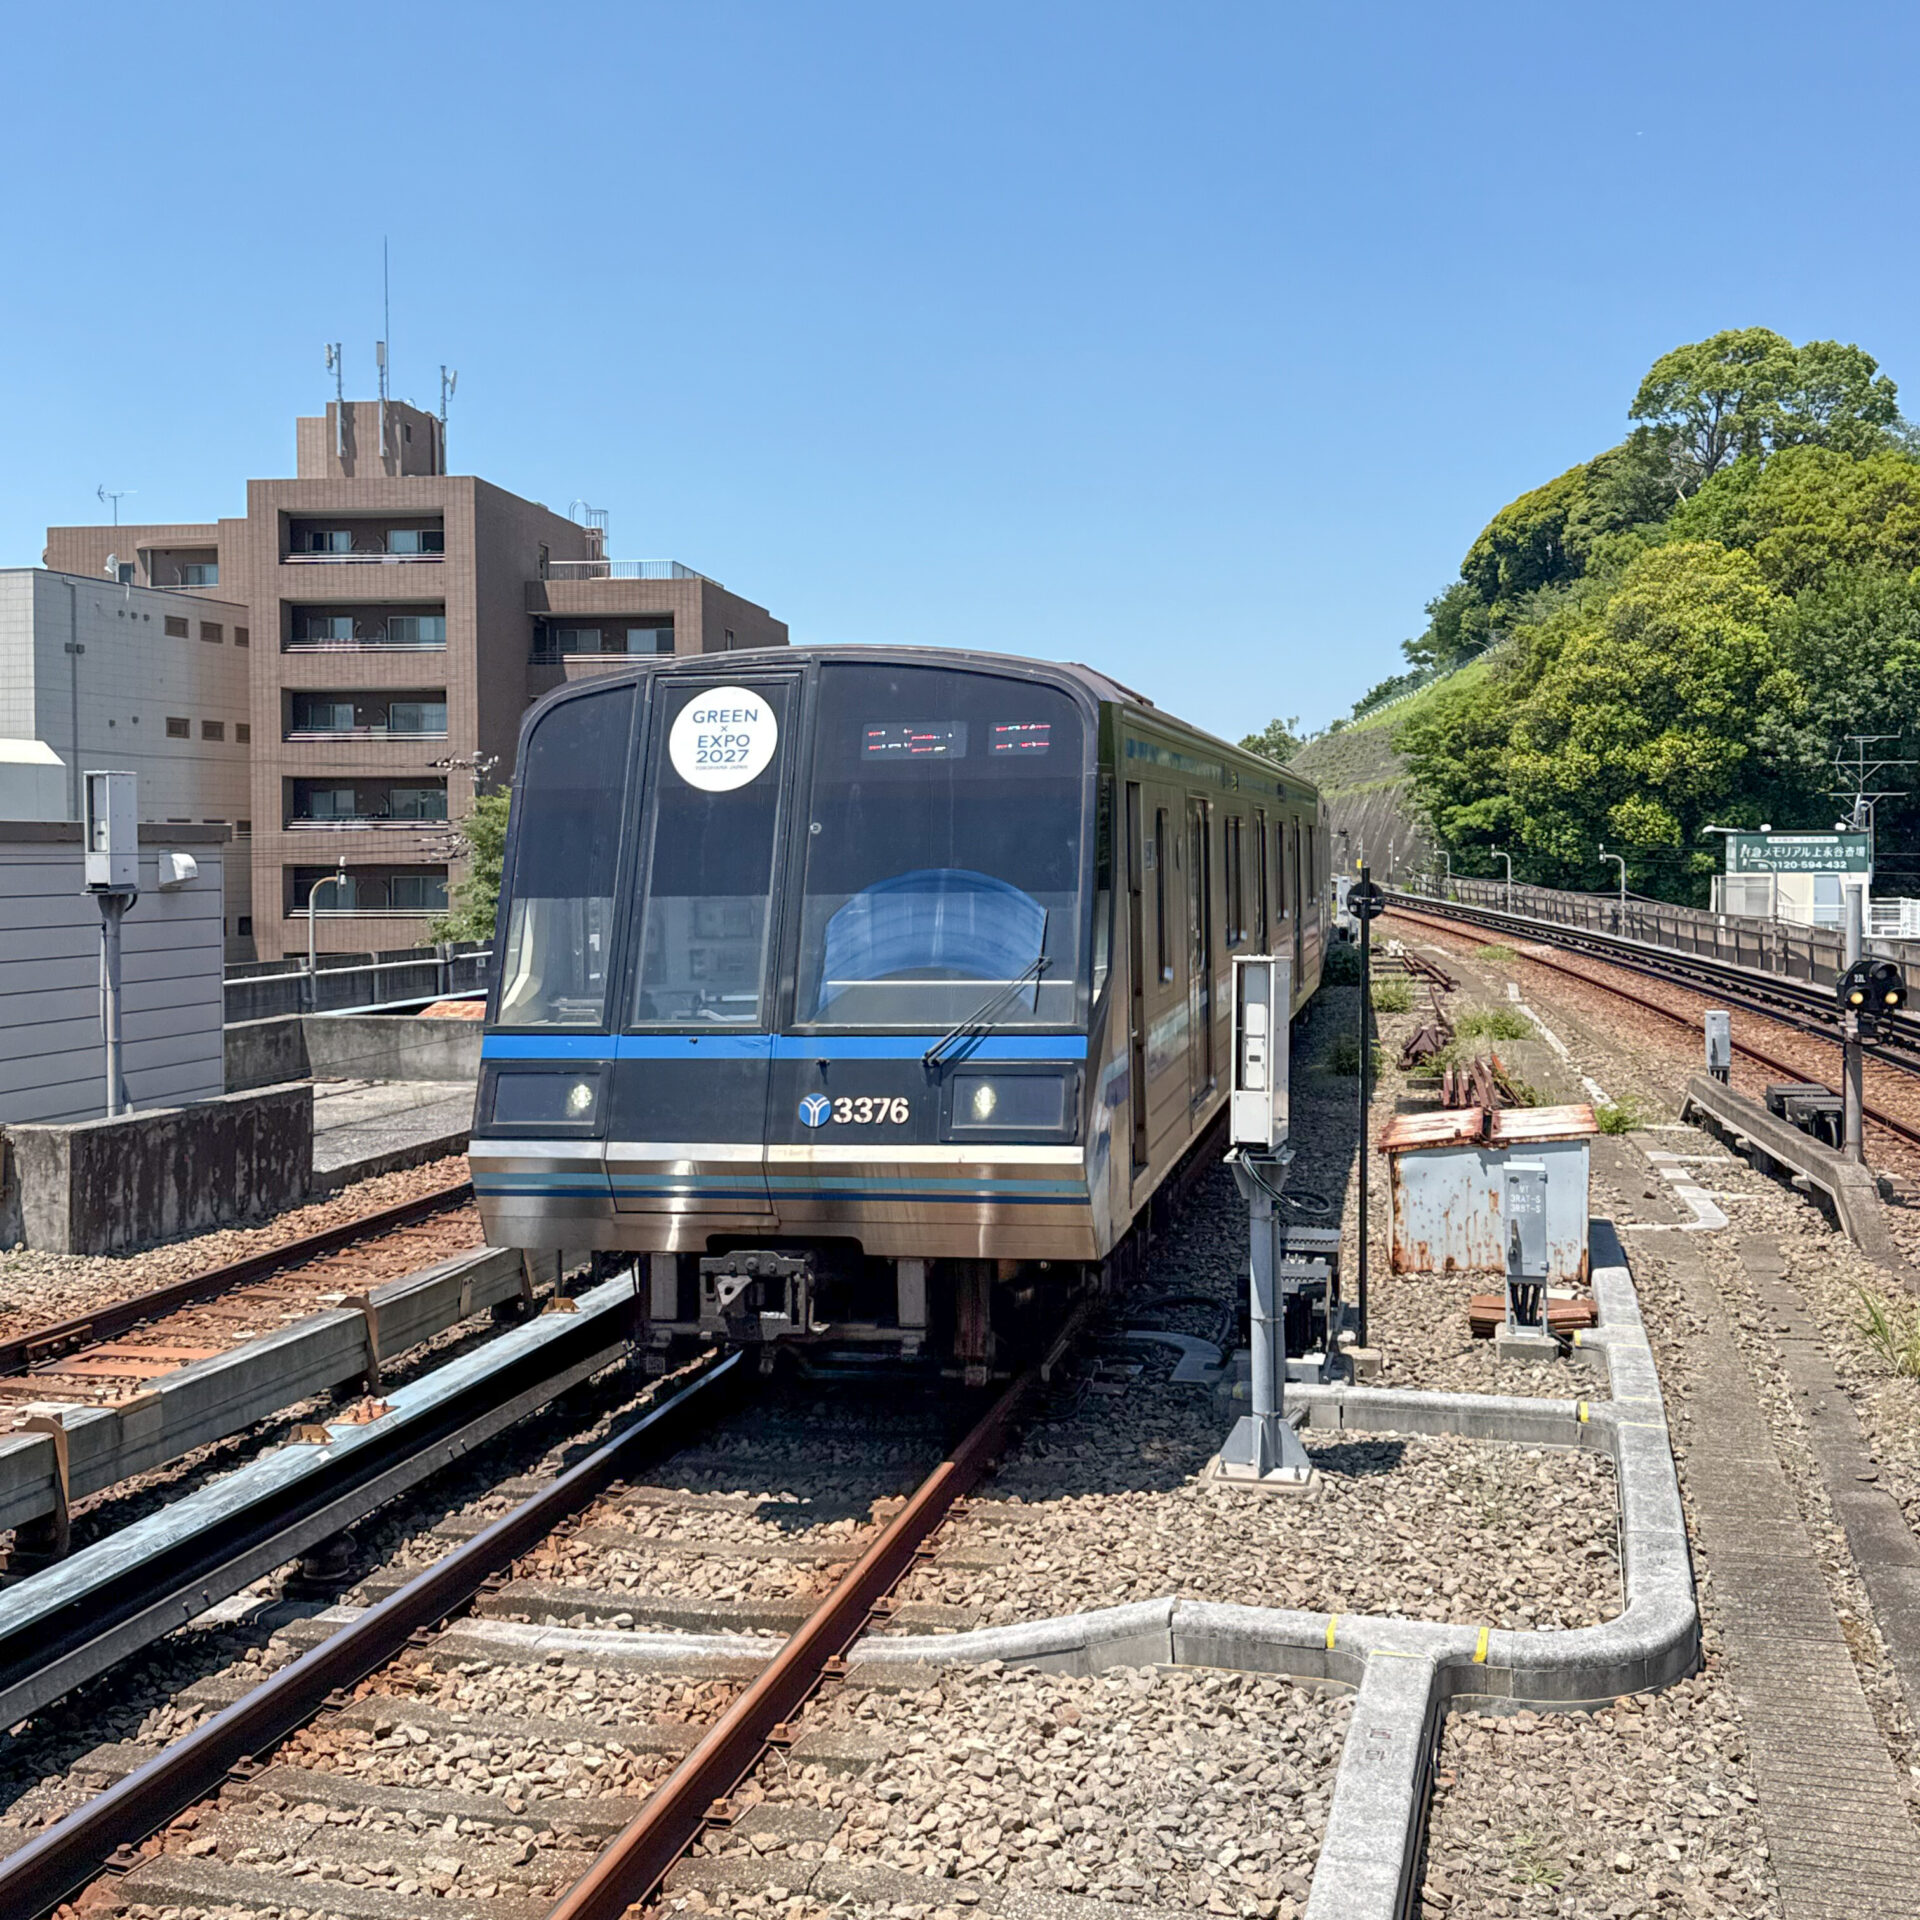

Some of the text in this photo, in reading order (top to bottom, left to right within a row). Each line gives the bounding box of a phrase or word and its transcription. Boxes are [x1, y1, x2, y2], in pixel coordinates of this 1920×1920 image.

[692, 709, 758, 724] GREEN
[697, 734, 750, 748] EXPO
[696, 749, 749, 763] 2027
[833, 1096, 909, 1124] 3376
